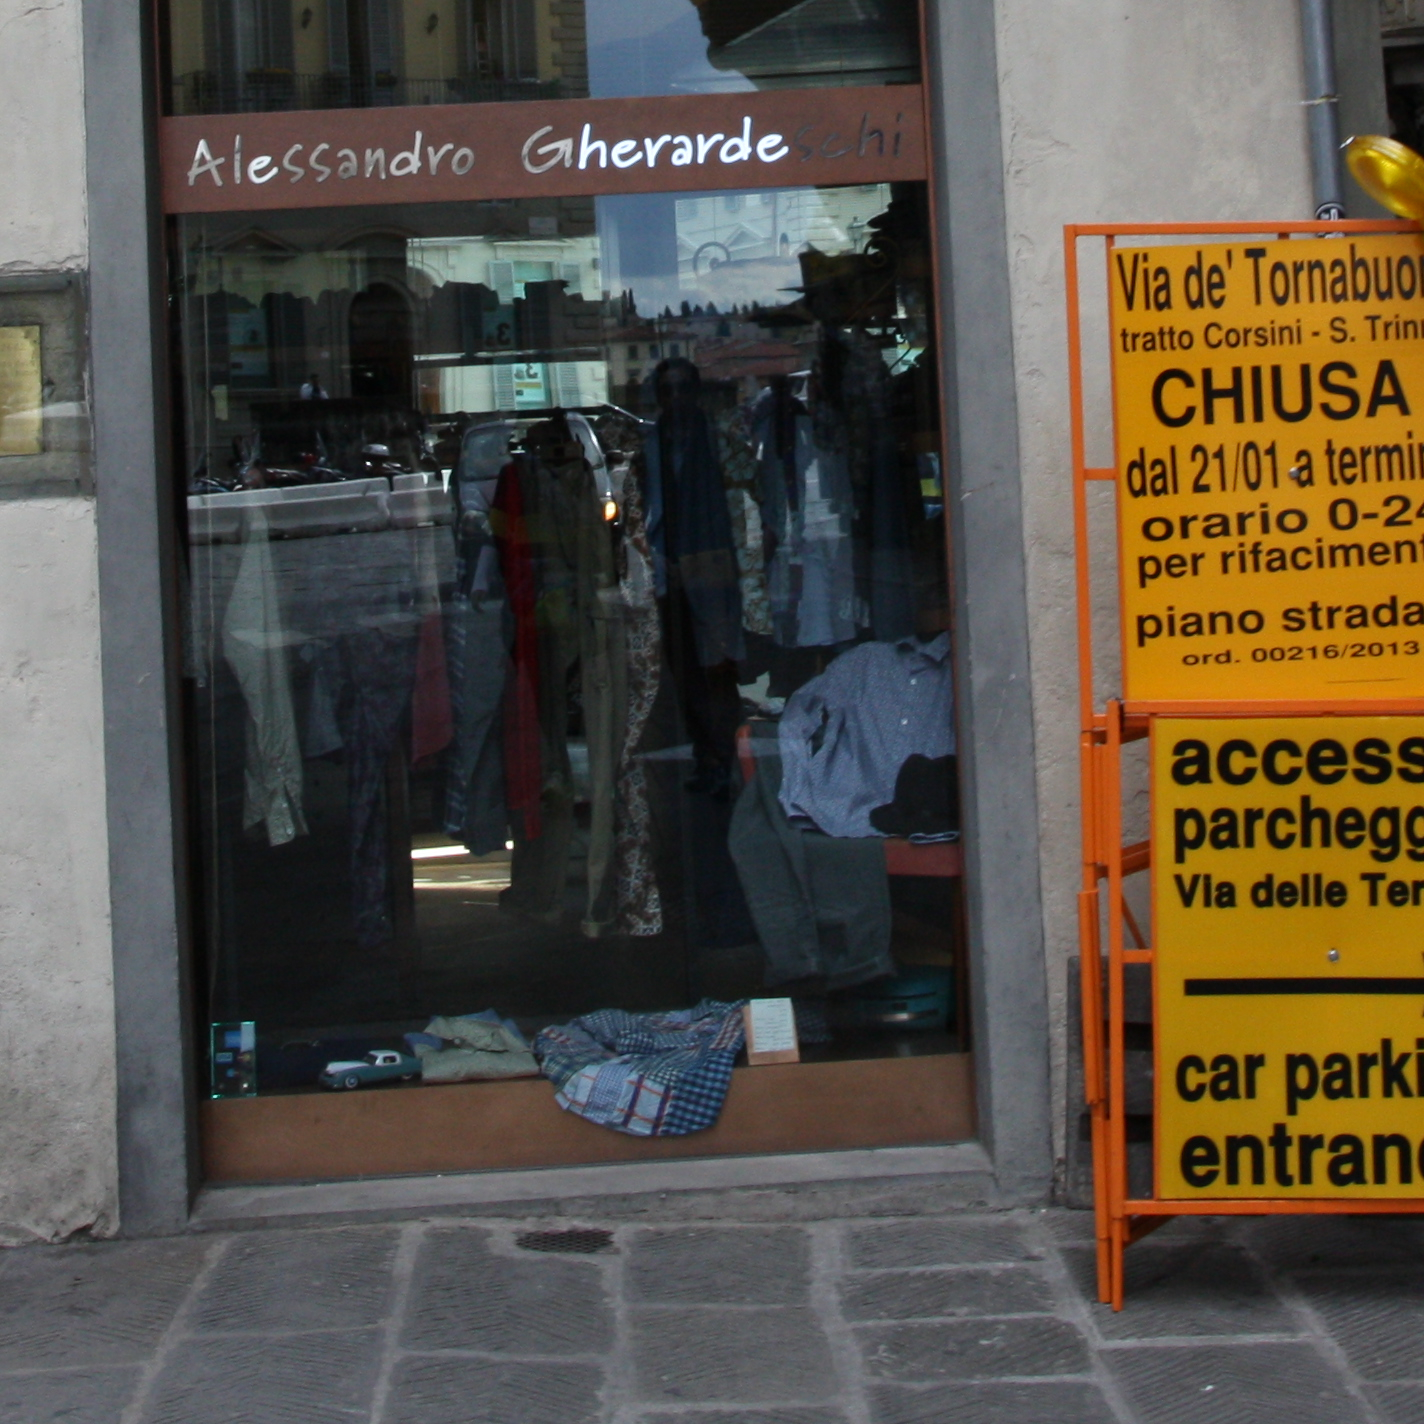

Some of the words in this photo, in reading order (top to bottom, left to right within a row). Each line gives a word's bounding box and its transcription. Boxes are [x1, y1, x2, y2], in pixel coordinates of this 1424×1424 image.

[187, 129, 476, 188] Alessandro
[521, 112, 905, 175] Gherardeschi
[1116, 252, 1173, 312] Via
[1184, 248, 1233, 310] de'
[1121, 325, 1194, 354] tratto
[1203, 319, 1302, 350] Corsini
[1329, 316, 1356, 344] S.
[1151, 359, 1411, 428] CHIUSA
[1127, 445, 1179, 499] dal
[1190, 439, 1279, 494] 21/01
[1294, 449, 1314, 488] a
[1141, 502, 1308, 543] orario
[1137, 550, 1206, 589] per
[1136, 604, 1265, 647] piano
[1181, 647, 1241, 666] ord.
[1251, 640, 1421, 663] 00216/2013
[1250, 873, 1348, 908] delle
[1175, 1051, 1265, 1103] car
